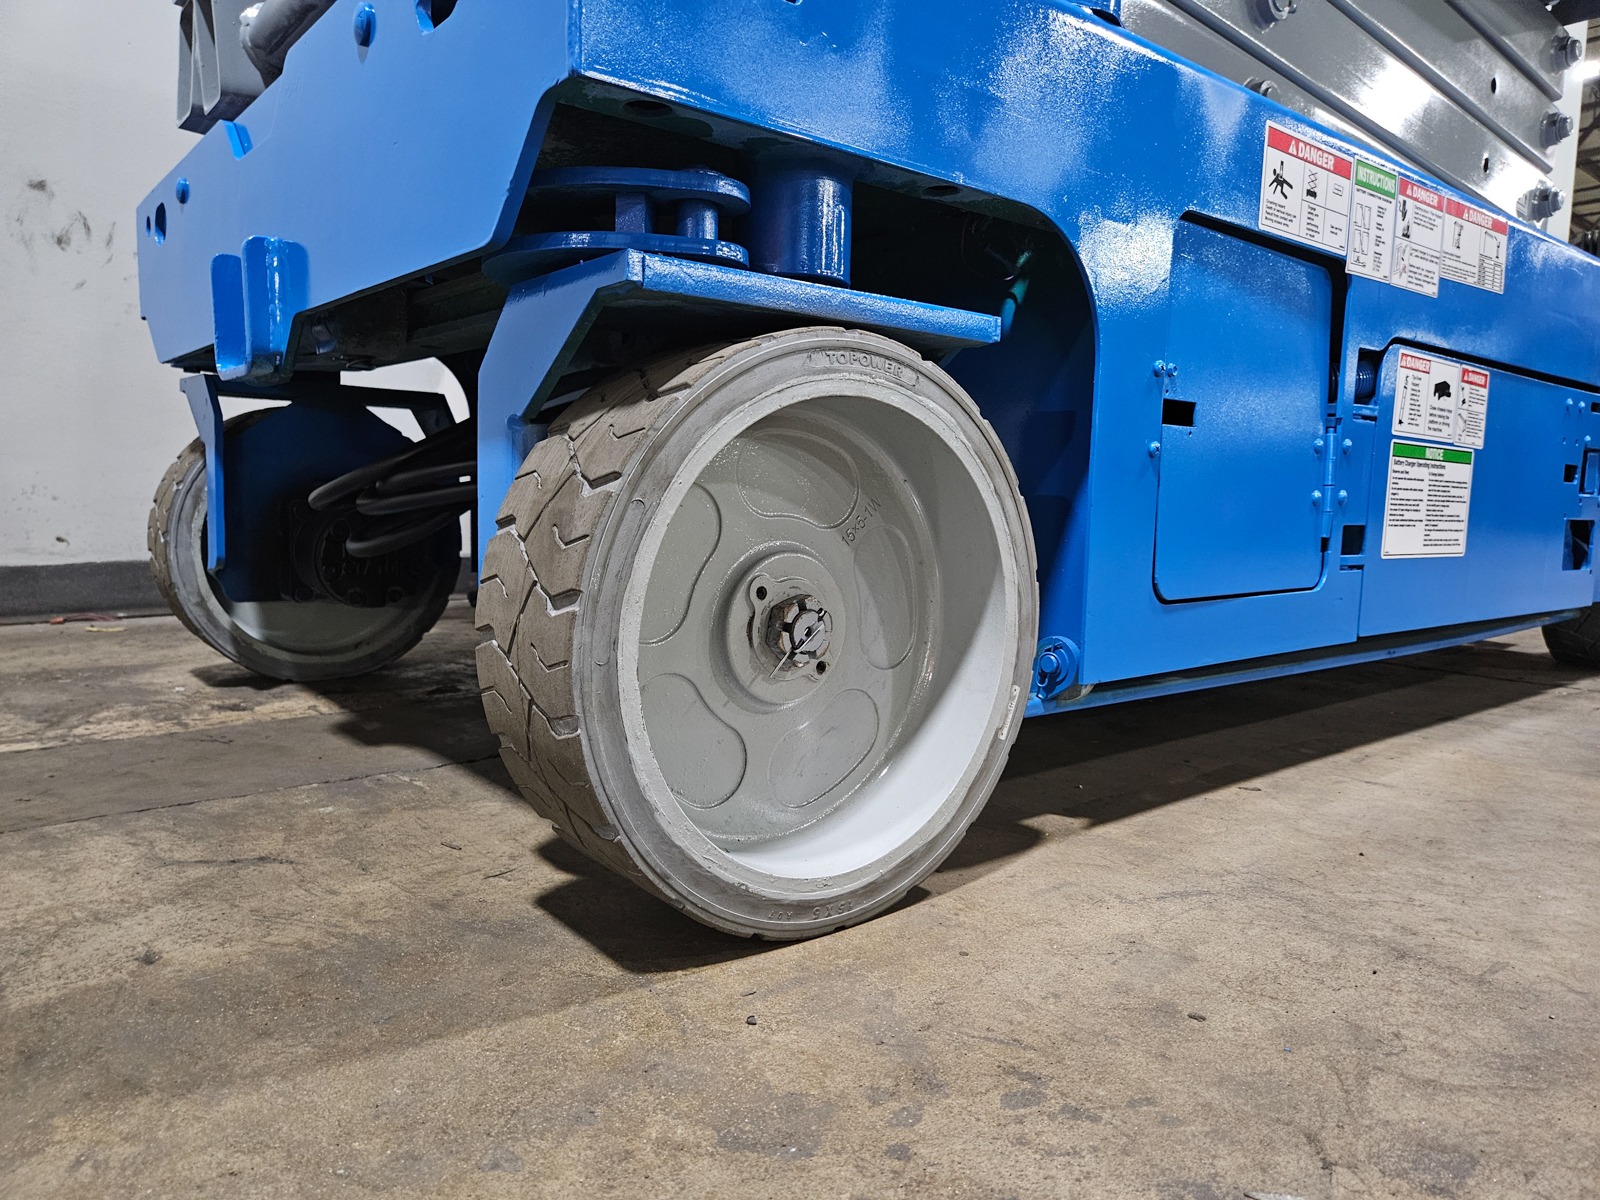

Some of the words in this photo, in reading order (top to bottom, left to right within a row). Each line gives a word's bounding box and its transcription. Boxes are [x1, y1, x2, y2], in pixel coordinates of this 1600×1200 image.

[1296, 140, 1335, 171] DANGER
[1357, 165, 1396, 193] INSTRUCTIONS
[1412, 184, 1438, 206] DANGER
[1469, 210, 1493, 229] DANGER
[826, 351, 904, 379] TOPOWER
[1406, 355, 1430, 372] DANGER
[1468, 370, 1486, 384] DANGER
[1425, 448, 1444, 460] NOTICE
[841, 497, 882, 547] 15x5-1W
